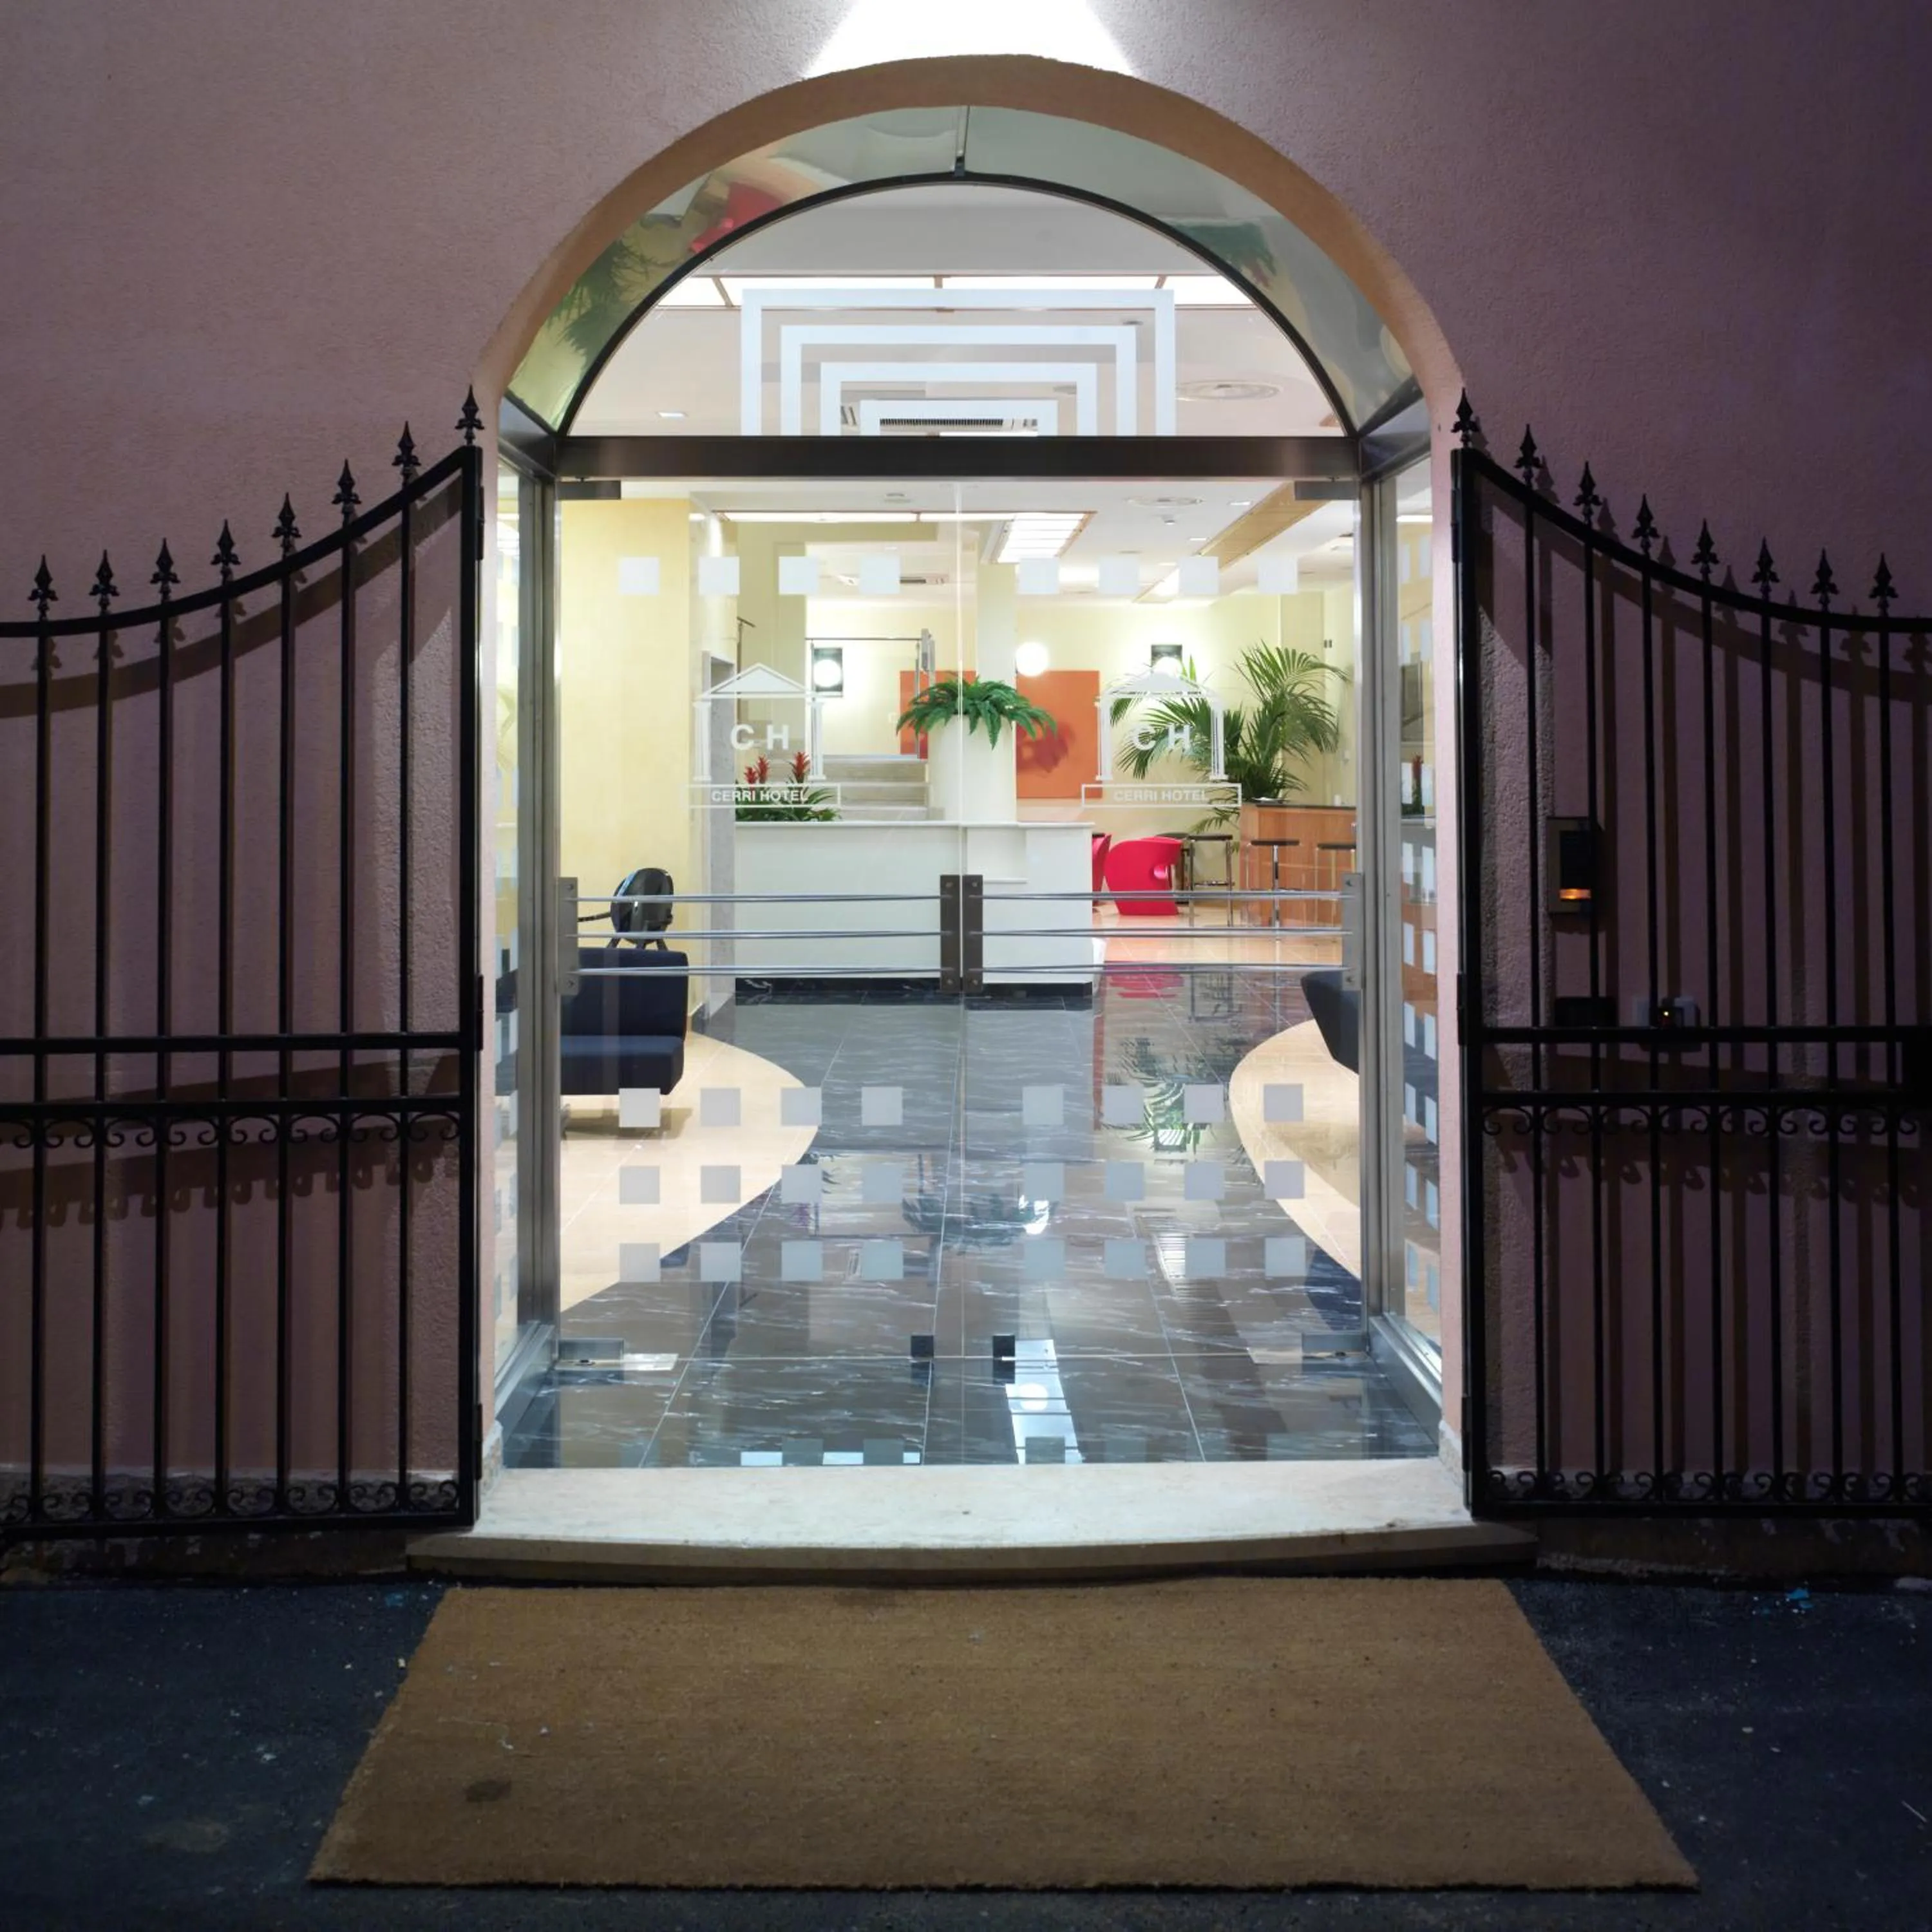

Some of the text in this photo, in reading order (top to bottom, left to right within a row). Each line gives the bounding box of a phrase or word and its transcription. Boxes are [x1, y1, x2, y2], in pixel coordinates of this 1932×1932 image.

[711, 790, 808, 802] CERRI HOTEL
[1113, 789, 1208, 800] CERRI HOTEL
